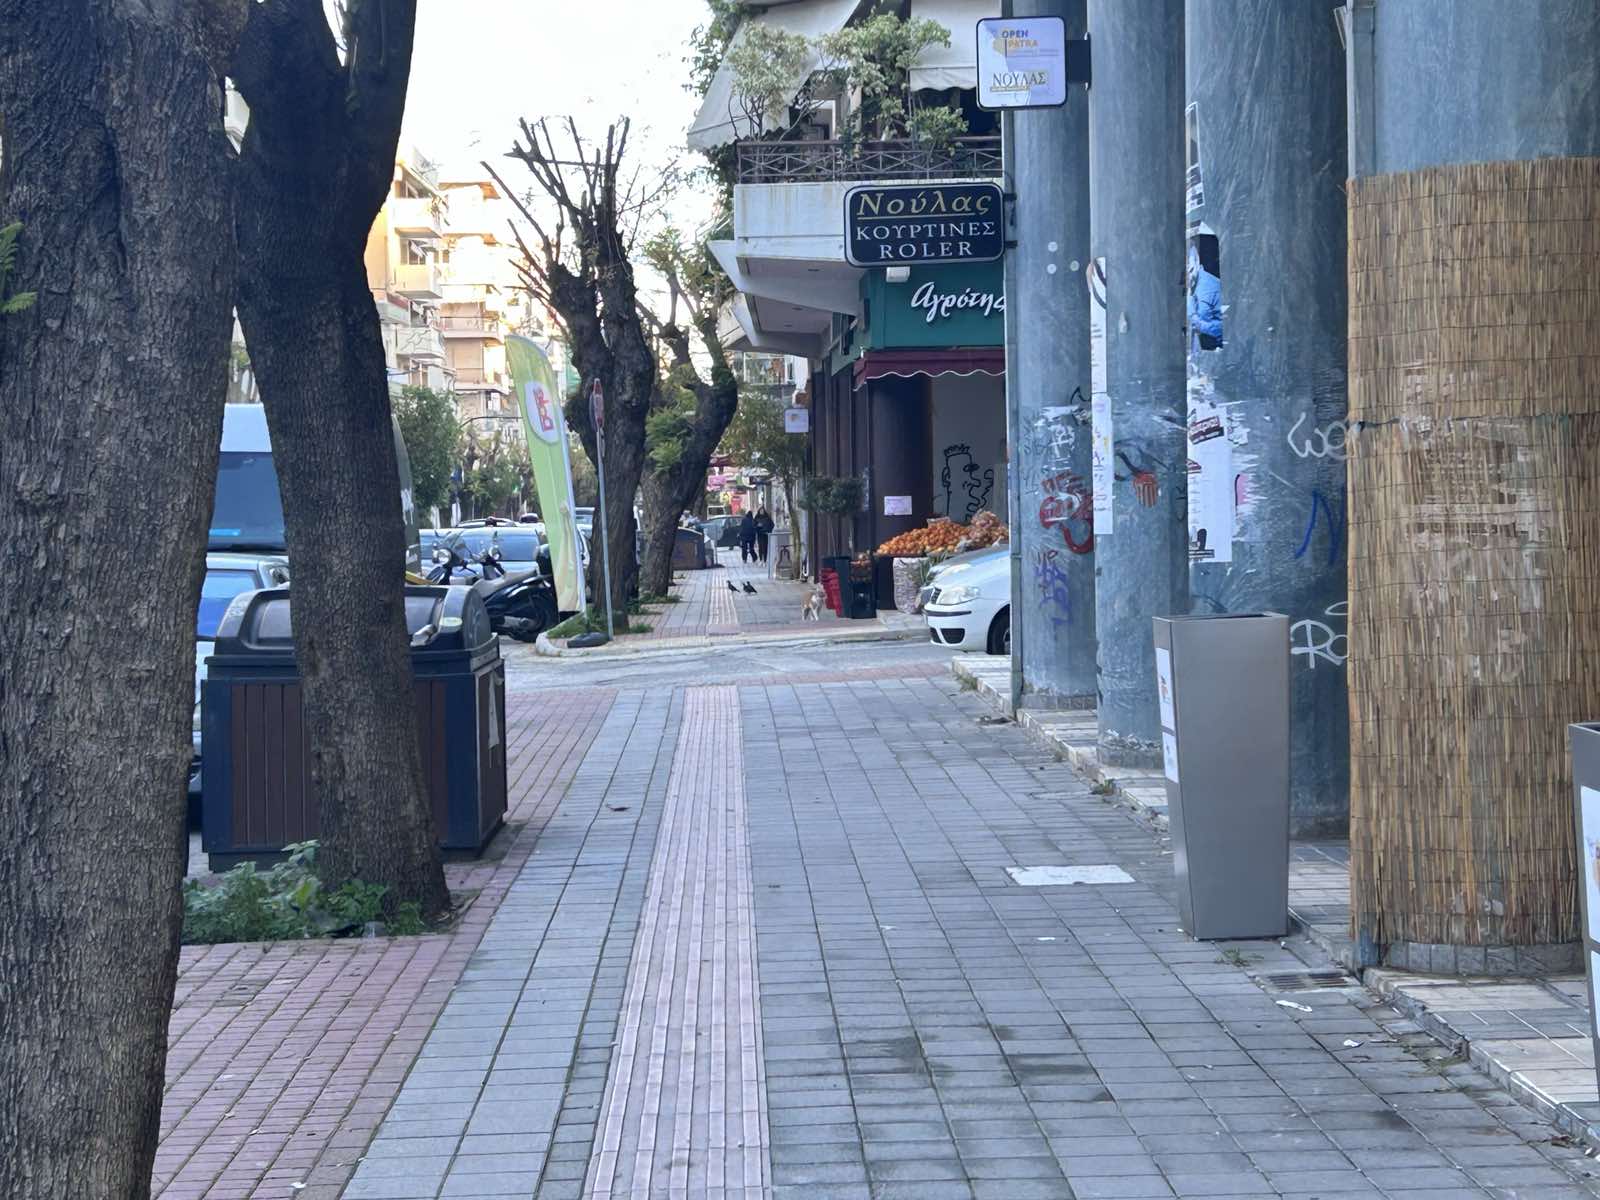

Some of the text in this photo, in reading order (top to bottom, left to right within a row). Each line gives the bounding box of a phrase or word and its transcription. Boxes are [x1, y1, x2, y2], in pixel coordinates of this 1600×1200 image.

[1001, 29, 1029, 39] OPEN
[992, 72, 1047, 87] ΝΟΥΛΑΣ
[856, 190, 992, 216] Νούλας
[856, 221, 996, 241] ΚΟΥΡΤΙΝΕΣ
[879, 241, 973, 259] ROLER
